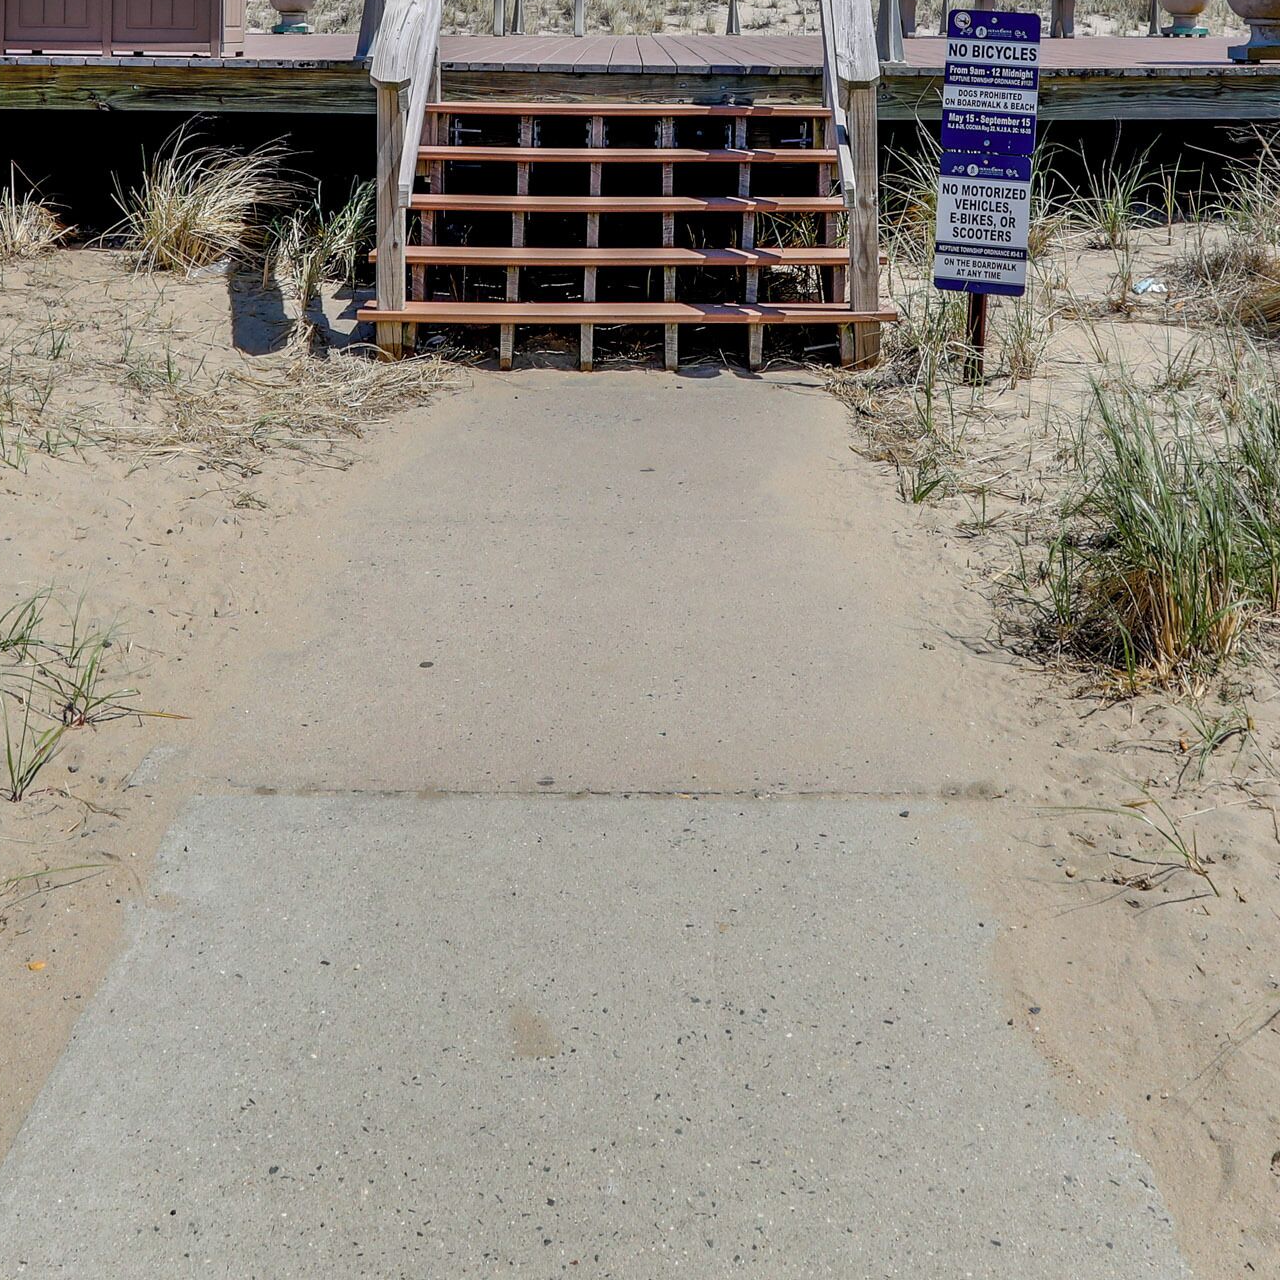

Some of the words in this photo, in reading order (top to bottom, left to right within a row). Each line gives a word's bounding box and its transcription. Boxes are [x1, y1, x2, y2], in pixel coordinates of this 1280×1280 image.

[949, 44, 967, 57] NO
[972, 45, 1037, 61] BICYCLES
[950, 65, 967, 74] From
[970, 66, 985, 75] 9am
[992, 67, 1000, 76] 12
[1002, 68, 1033, 79] Midnight
[980, 90, 1022, 100] PROHIBITED
[957, 99, 1001, 109] BOARDWALK
[1011, 103, 1034, 111] BEACH
[949, 113, 964, 122] May
[965, 114, 974, 122] 15
[980, 115, 1020, 126] September
[1021, 118, 1030, 126] 15
[942, 183, 958, 195] NO
[962, 185, 1026, 200] MOTORIZED
[955, 199, 1012, 216] VEHICLES,
[950, 212, 996, 229] E-BIKES,
[1000, 217, 1016, 228] OR
[952, 227, 1012, 242] SCOOTERS
[956, 259, 970, 267] THE
[973, 260, 1016, 272] BOARDWALK
[967, 269, 982, 278] ANY
[984, 271, 1001, 279] TIME
